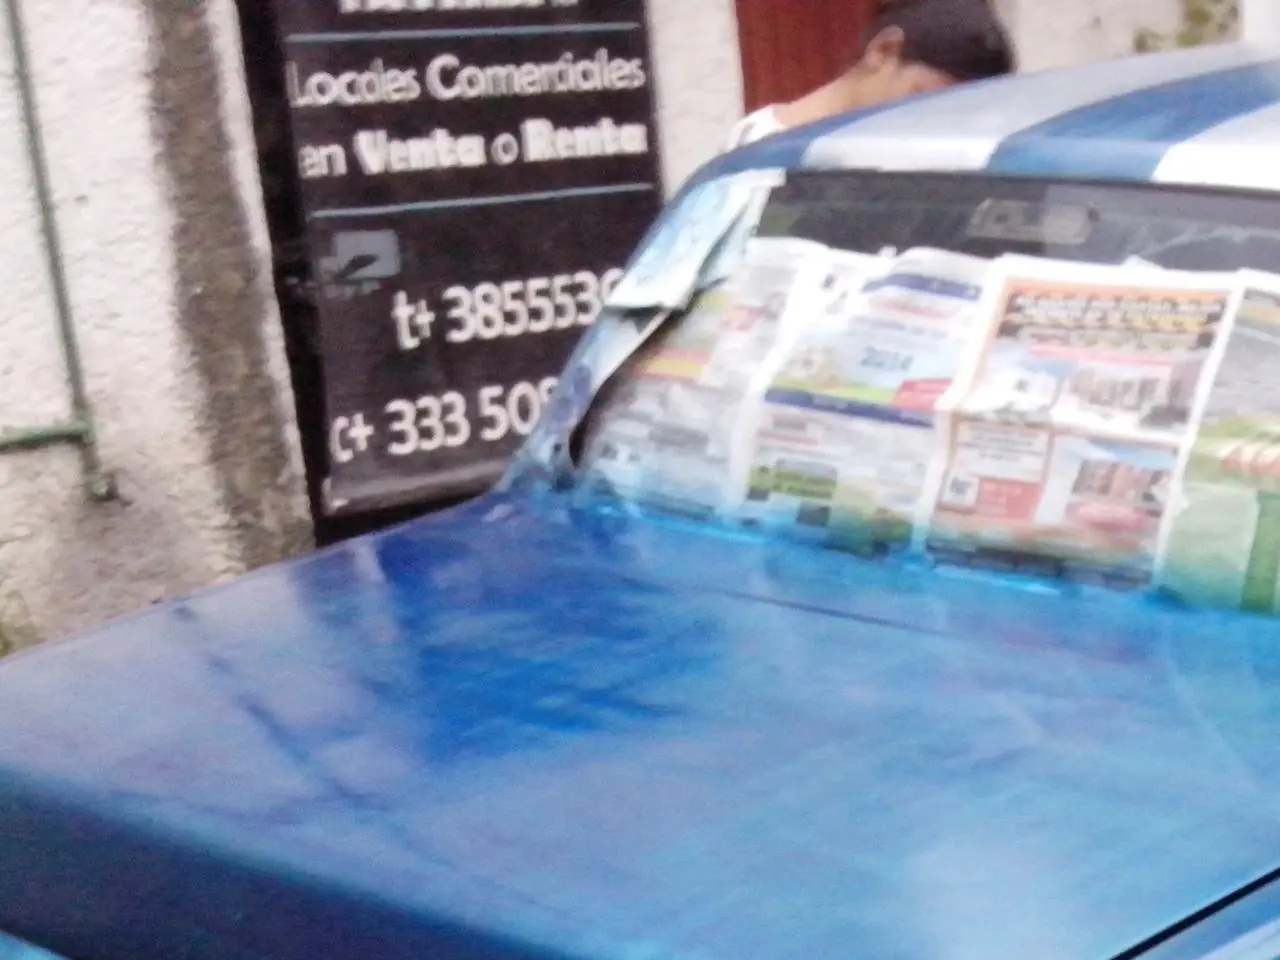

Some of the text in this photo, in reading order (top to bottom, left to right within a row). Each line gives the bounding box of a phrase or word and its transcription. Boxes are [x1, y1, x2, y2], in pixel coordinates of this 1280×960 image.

[285, 47, 645, 108] Locales Comerciales
[299, 117, 649, 179] en Venta o Renta
[383, 391, 471, 456] 333
